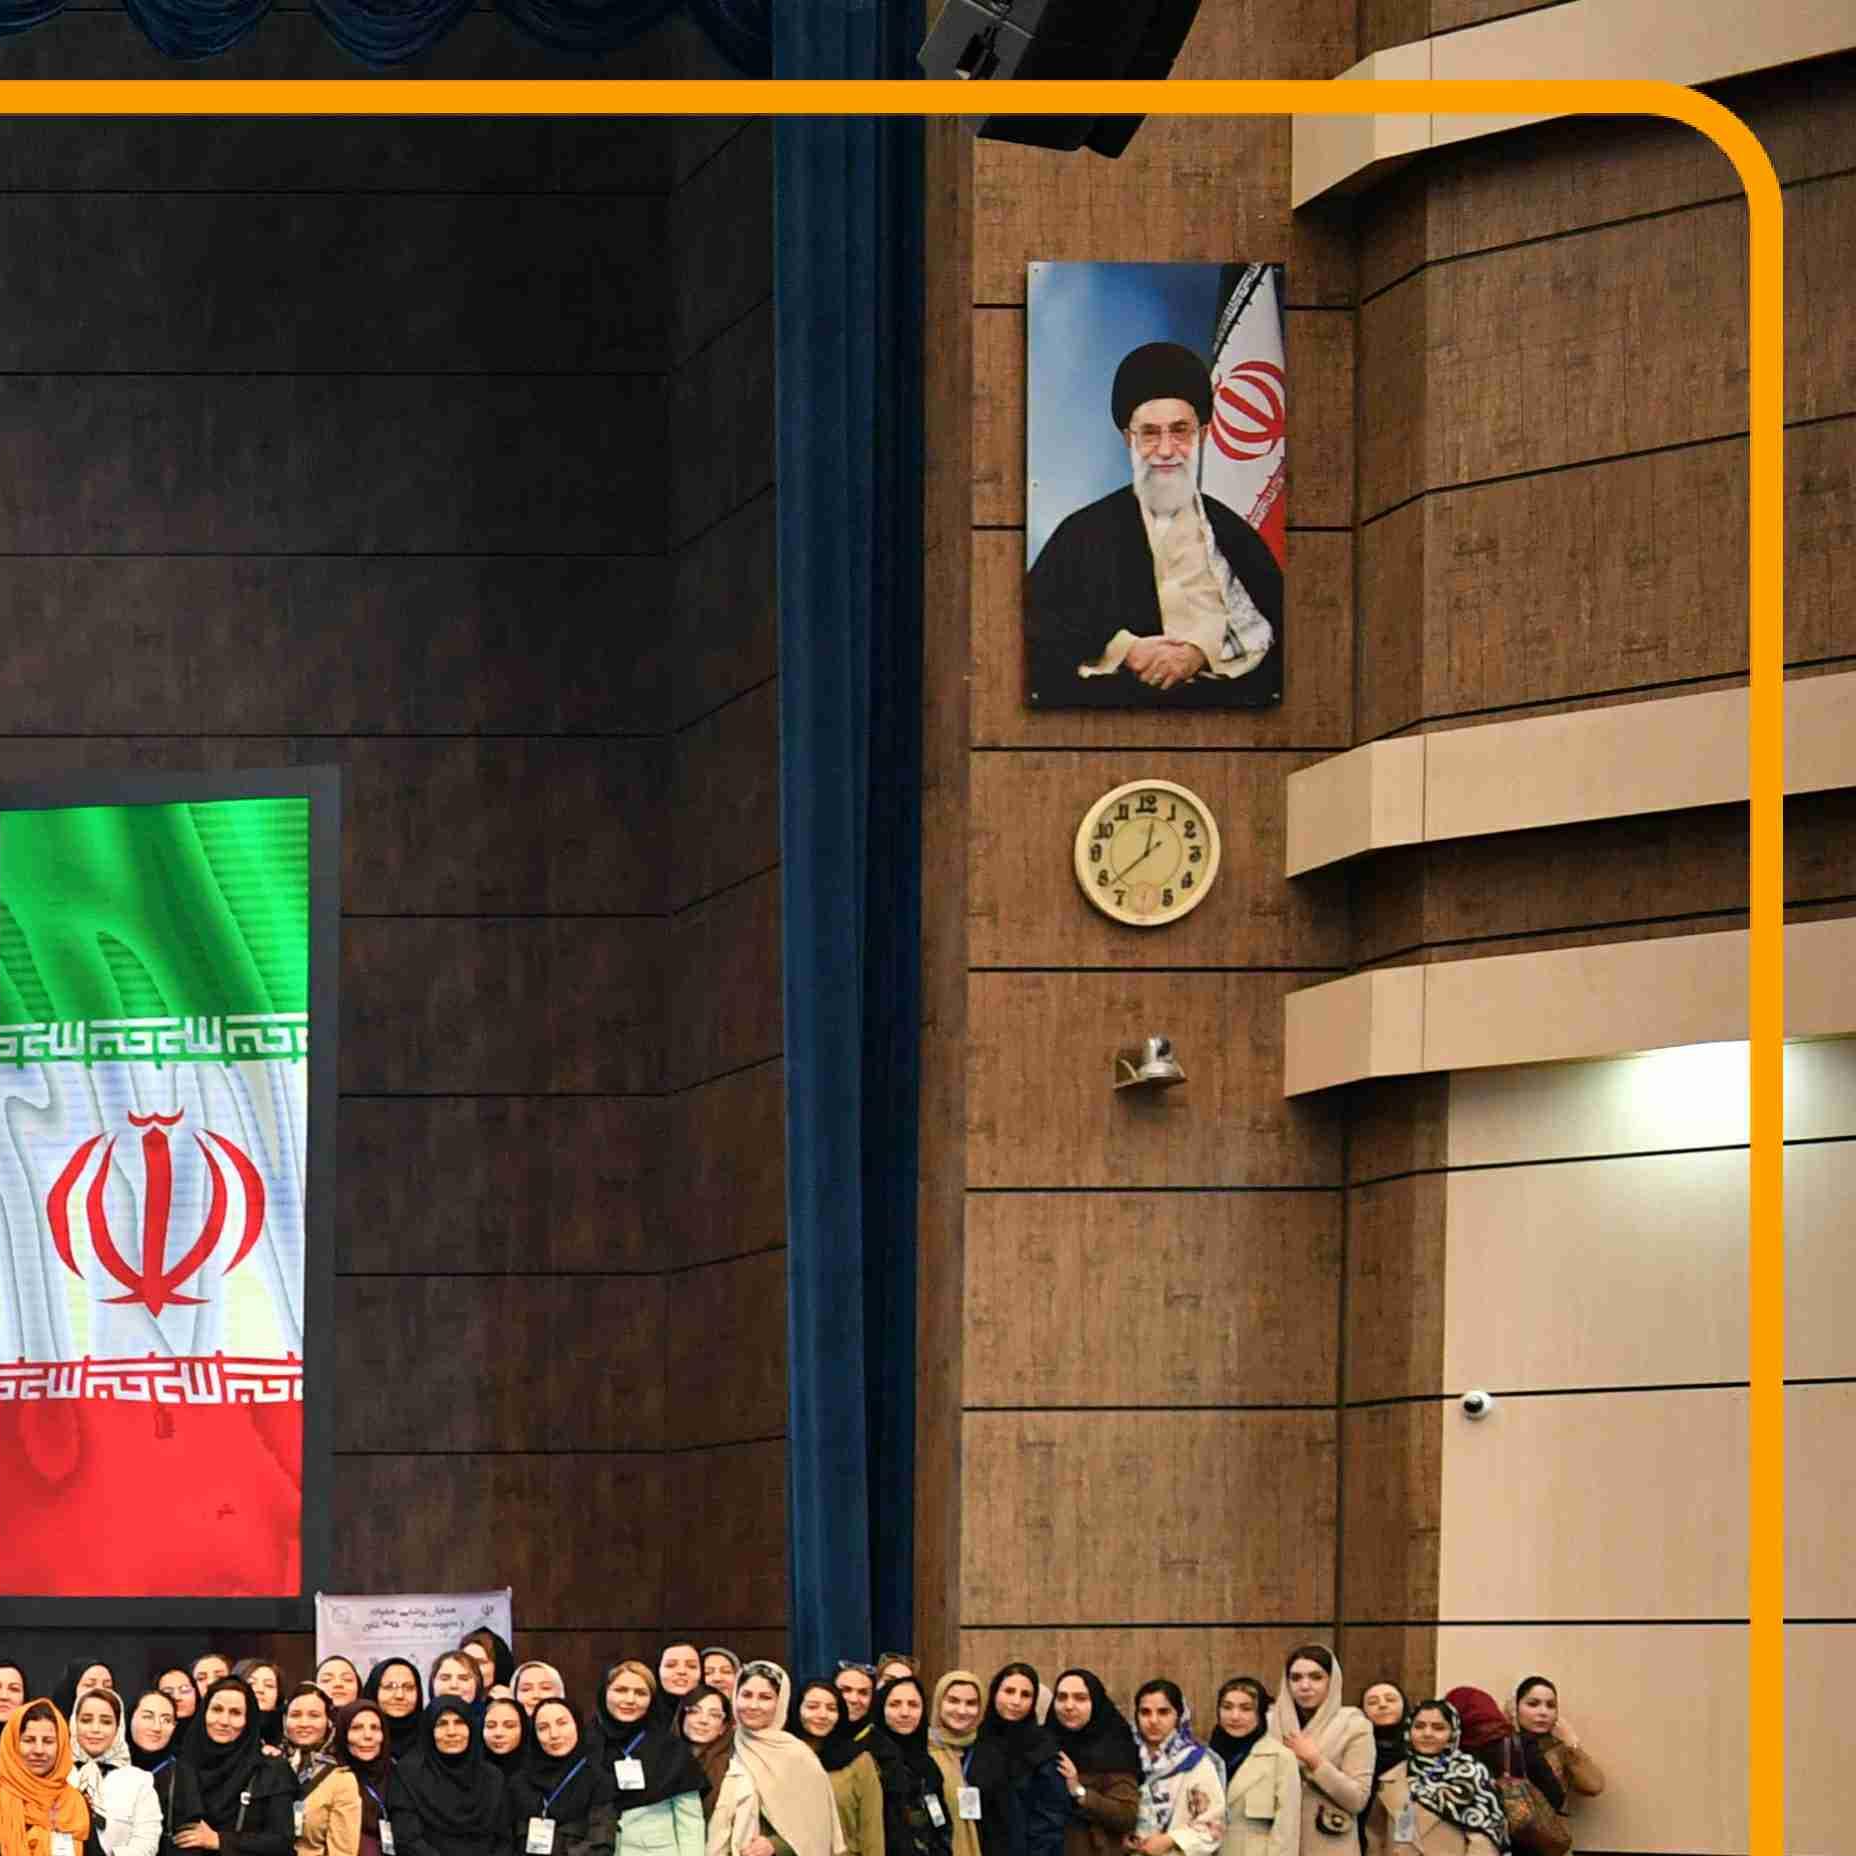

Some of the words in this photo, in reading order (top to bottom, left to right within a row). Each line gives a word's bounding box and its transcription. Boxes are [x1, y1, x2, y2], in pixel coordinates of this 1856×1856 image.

[1114, 803, 1129, 821] 11
[1136, 795, 1157, 813] 12
[1166, 804, 1176, 820] 1
[1093, 822, 1113, 839] 10
[1184, 820, 1196, 839] 2
[1090, 843, 1102, 863] 9
[1189, 845, 1202, 863] 3
[1097, 869, 1108, 887] 8
[1181, 871, 1193, 889] 4
[1113, 890, 1126, 906] 7
[1162, 889, 1173, 907] 5
